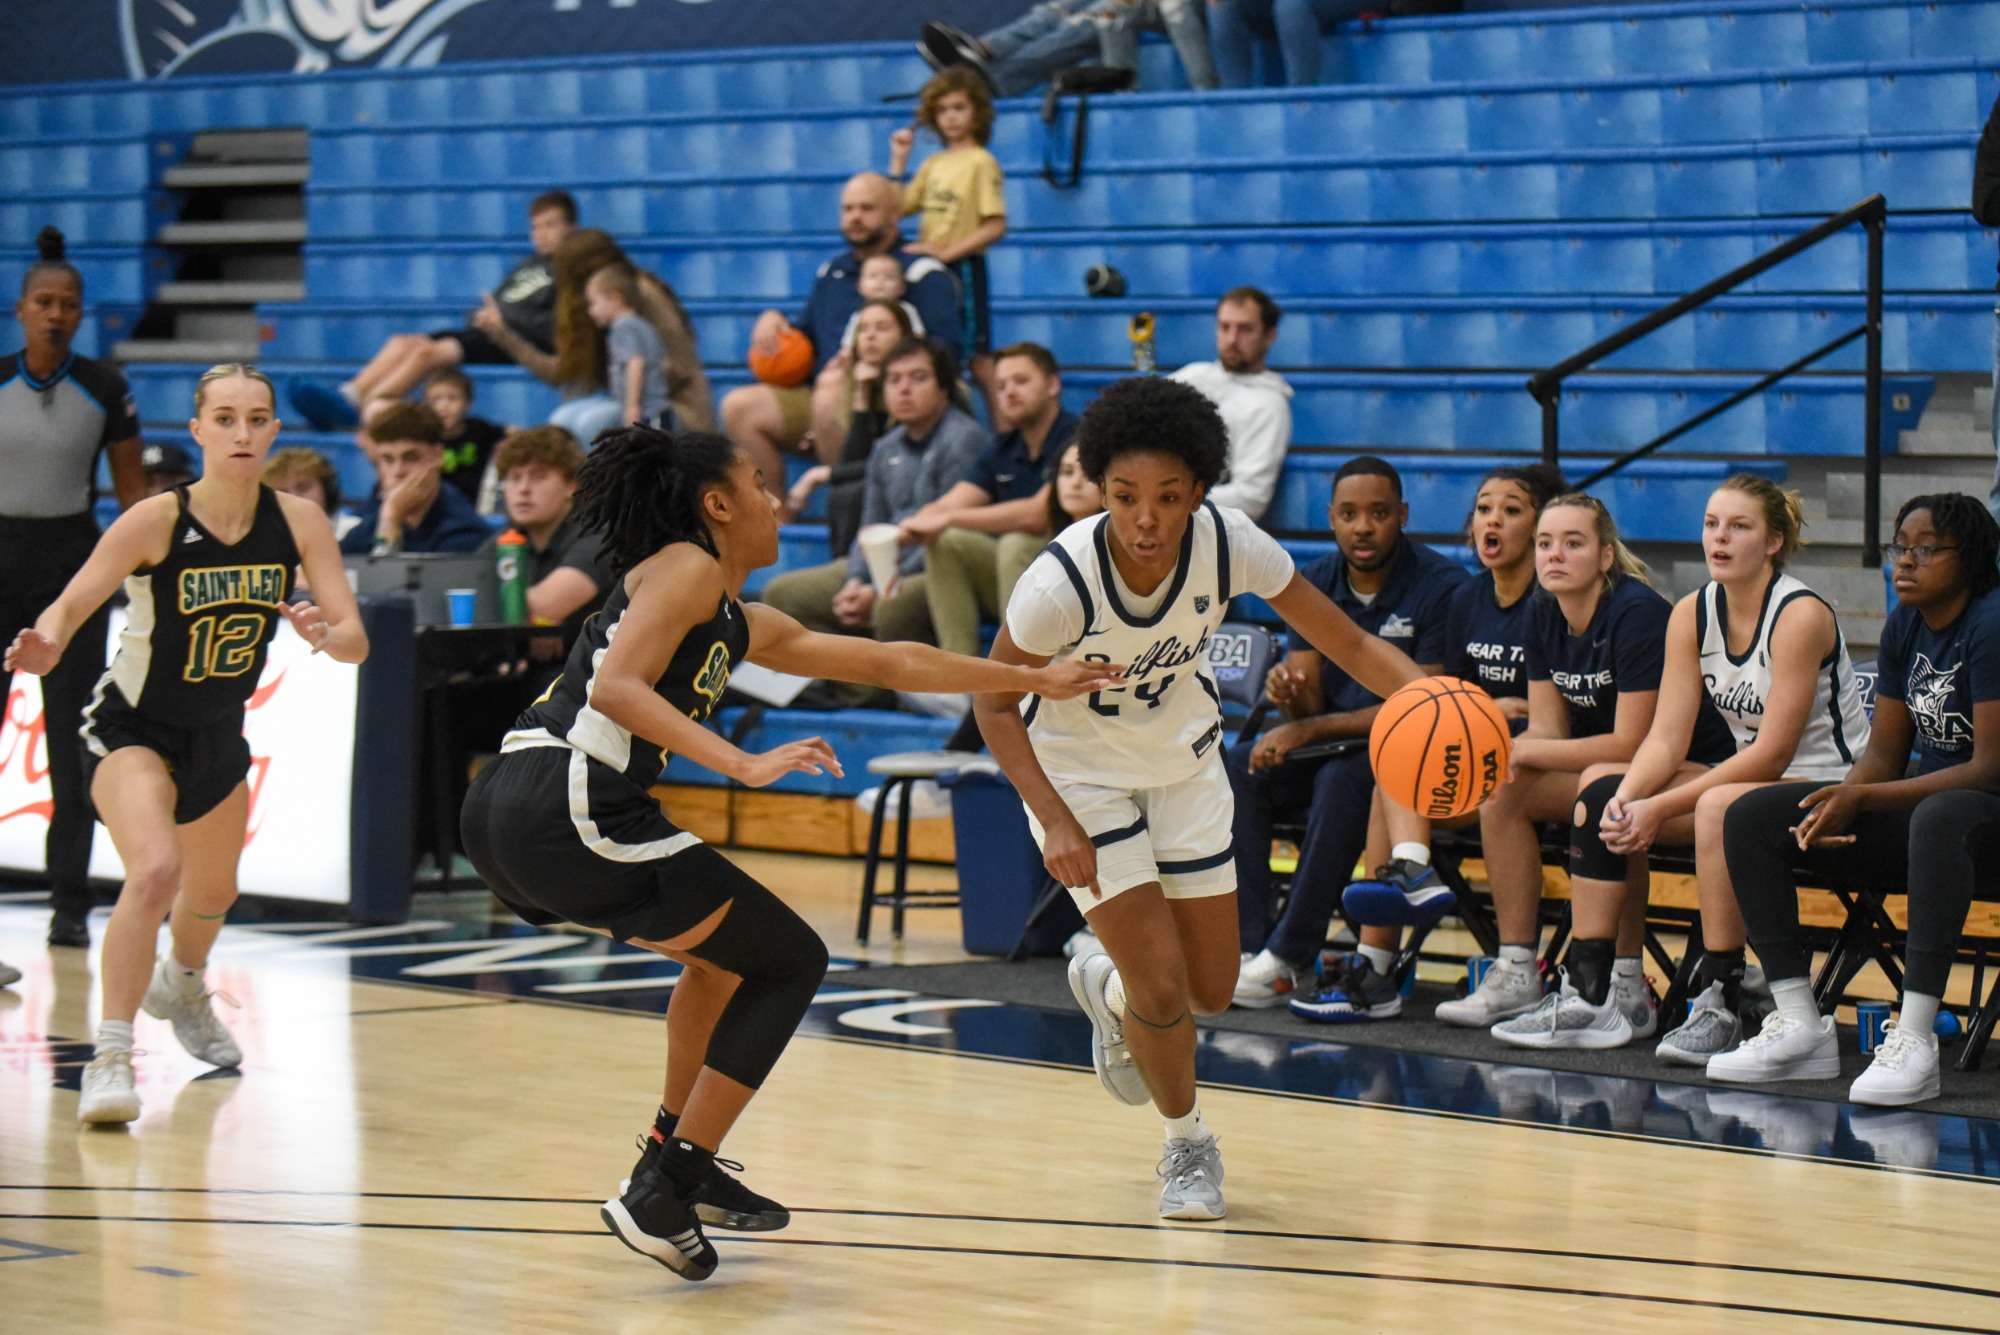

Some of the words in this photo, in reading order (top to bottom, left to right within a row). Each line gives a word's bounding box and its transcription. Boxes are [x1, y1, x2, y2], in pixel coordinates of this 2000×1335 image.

[180, 567, 243, 613] SAINT
[246, 565, 285, 607] LEO
[183, 613, 267, 683] 12
[1479, 664, 1516, 682] FISH
[1913, 710, 1974, 743] BA
[1426, 744, 1462, 816] Wilson
